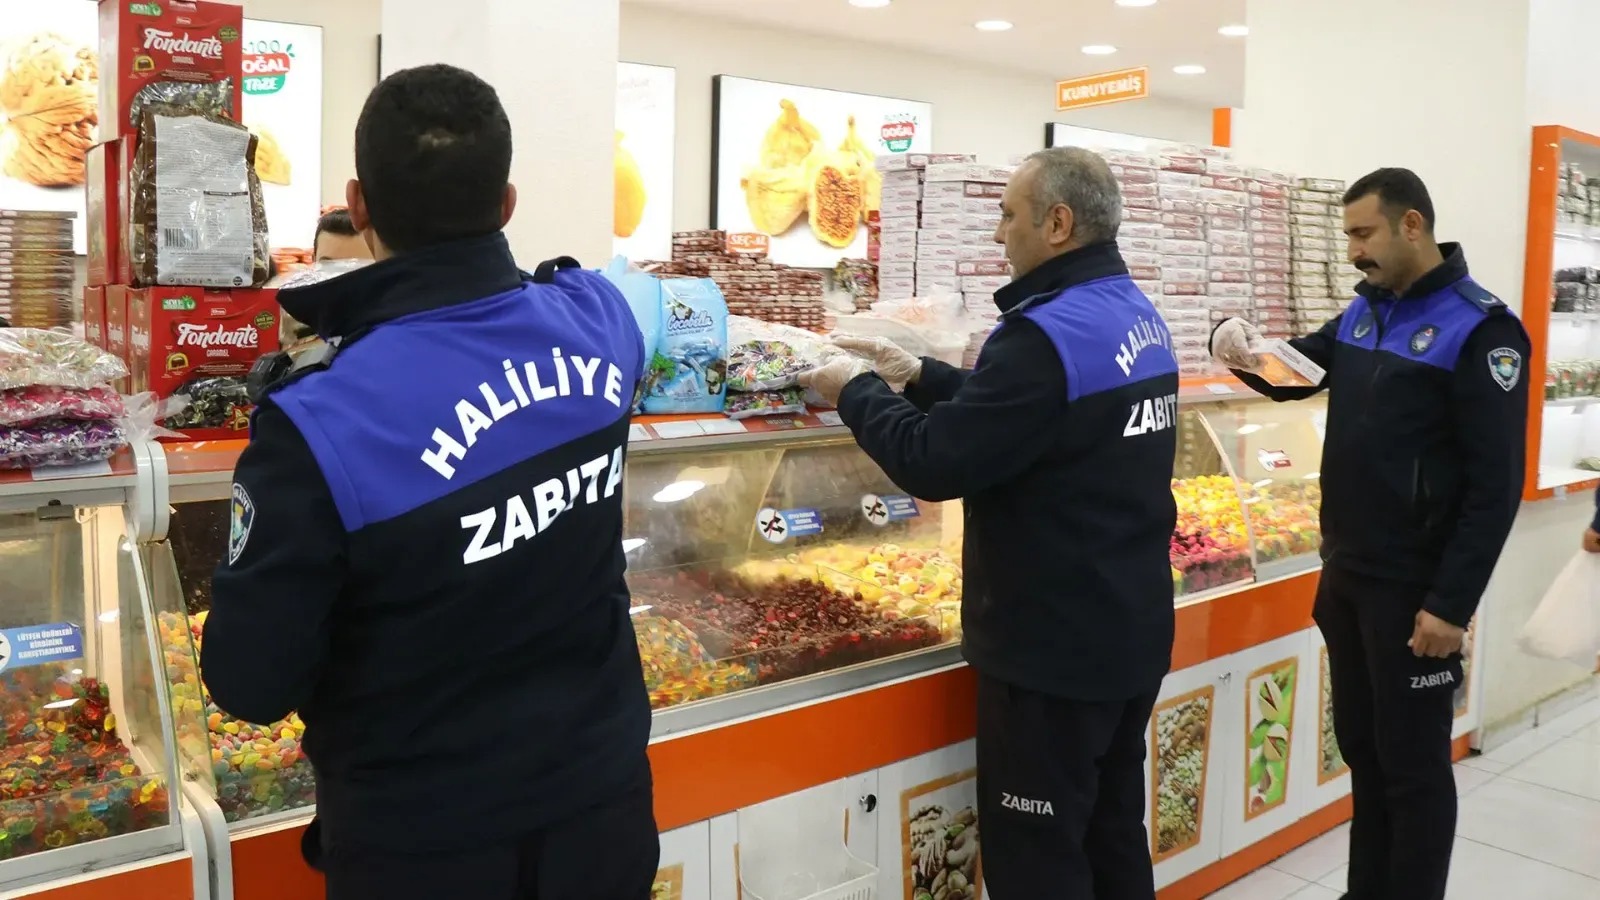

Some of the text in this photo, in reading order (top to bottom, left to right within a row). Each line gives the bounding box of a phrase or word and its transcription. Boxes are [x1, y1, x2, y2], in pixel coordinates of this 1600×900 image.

[143, 28, 222, 58] Fondante
[242, 40, 281, 54] 100
[242, 56, 289, 73] OĞAL
[1062, 75, 1141, 102] KURUYEMİŞ
[177, 323, 258, 349] Fondante
[420, 347, 623, 481] HALİLİYE
[1123, 393, 1177, 437] ZABIT
[460, 445, 623, 565] ZABITA
[1410, 670, 1455, 689] ZABITA
[1001, 791, 1054, 816] ZABITA
